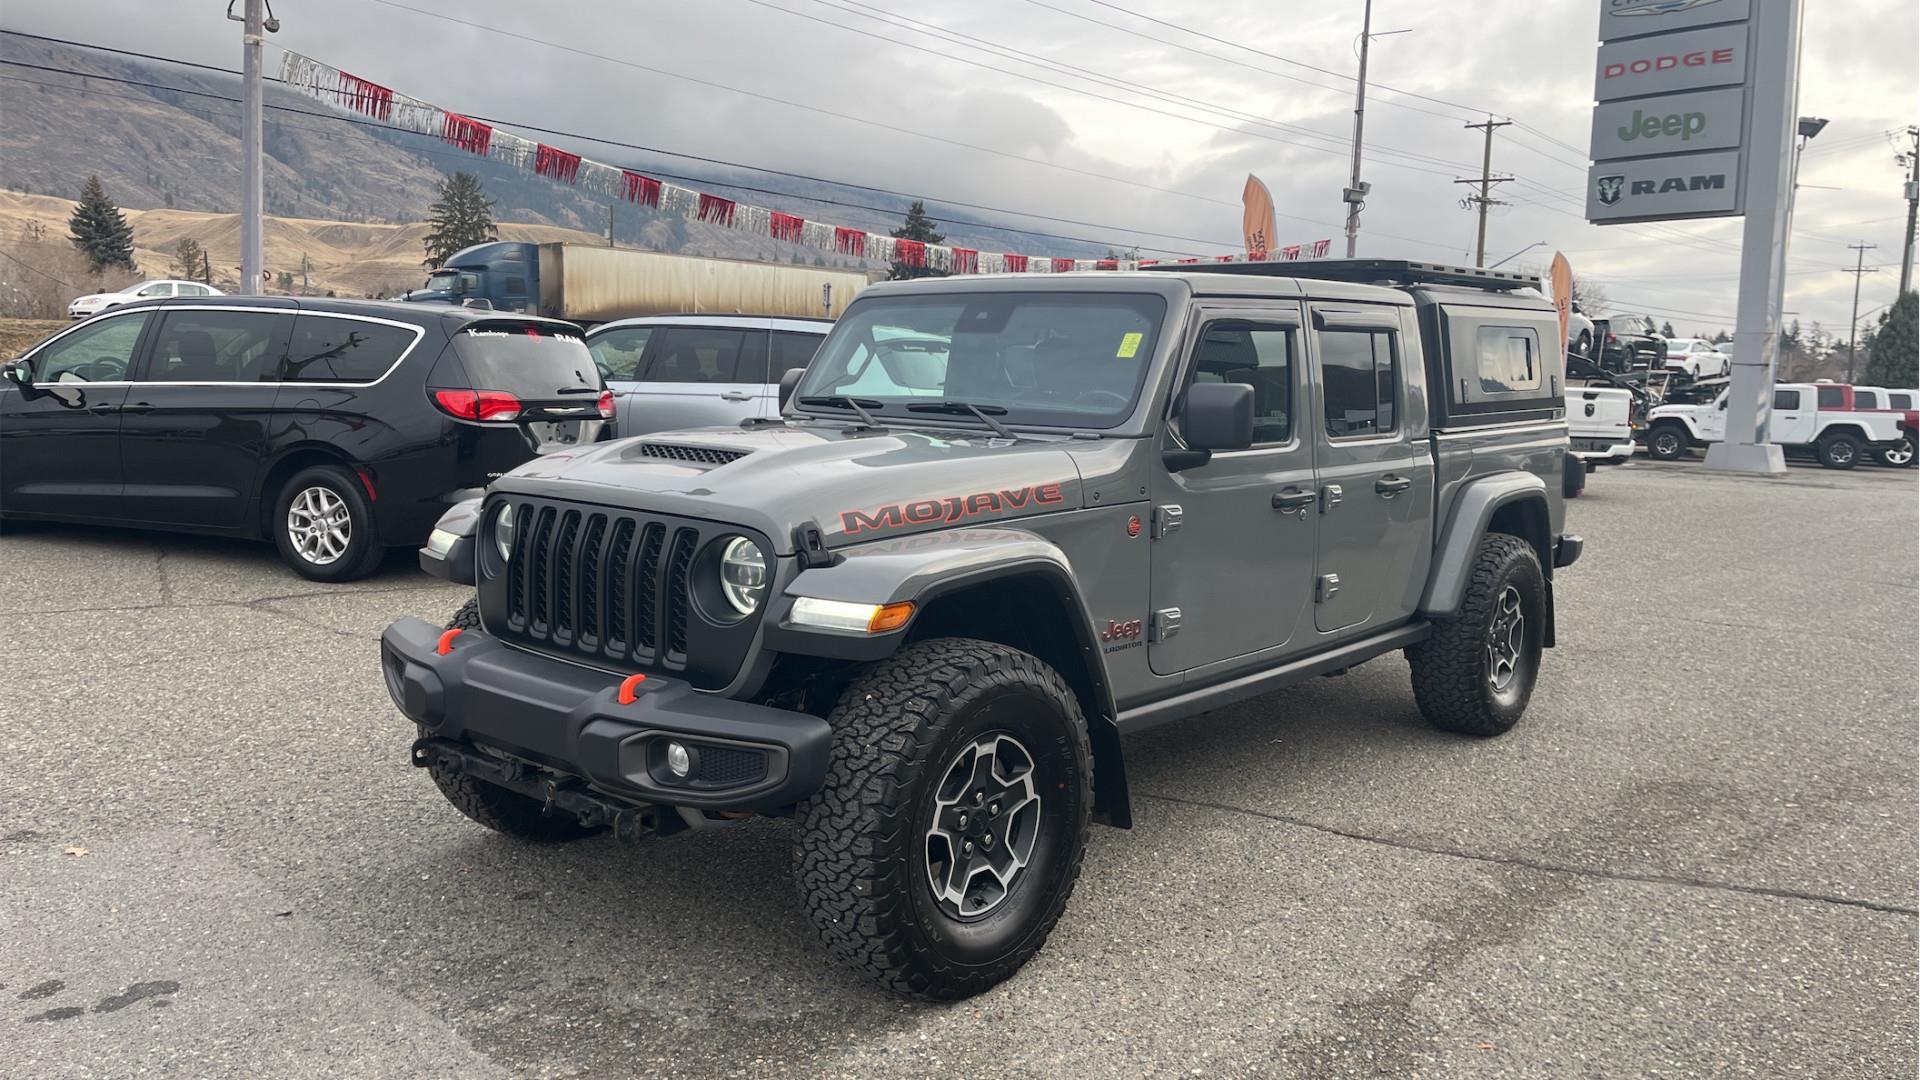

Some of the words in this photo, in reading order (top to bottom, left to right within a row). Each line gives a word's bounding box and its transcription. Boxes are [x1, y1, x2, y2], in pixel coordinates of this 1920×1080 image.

[1603, 48, 1734, 79] DODGE
[1617, 110, 1706, 141] Jeep
[1631, 174, 1725, 195] RAM
[553, 333, 584, 345] RAM
[838, 483, 1064, 535] MOJAVE
[1102, 618, 1141, 641] Jeep
